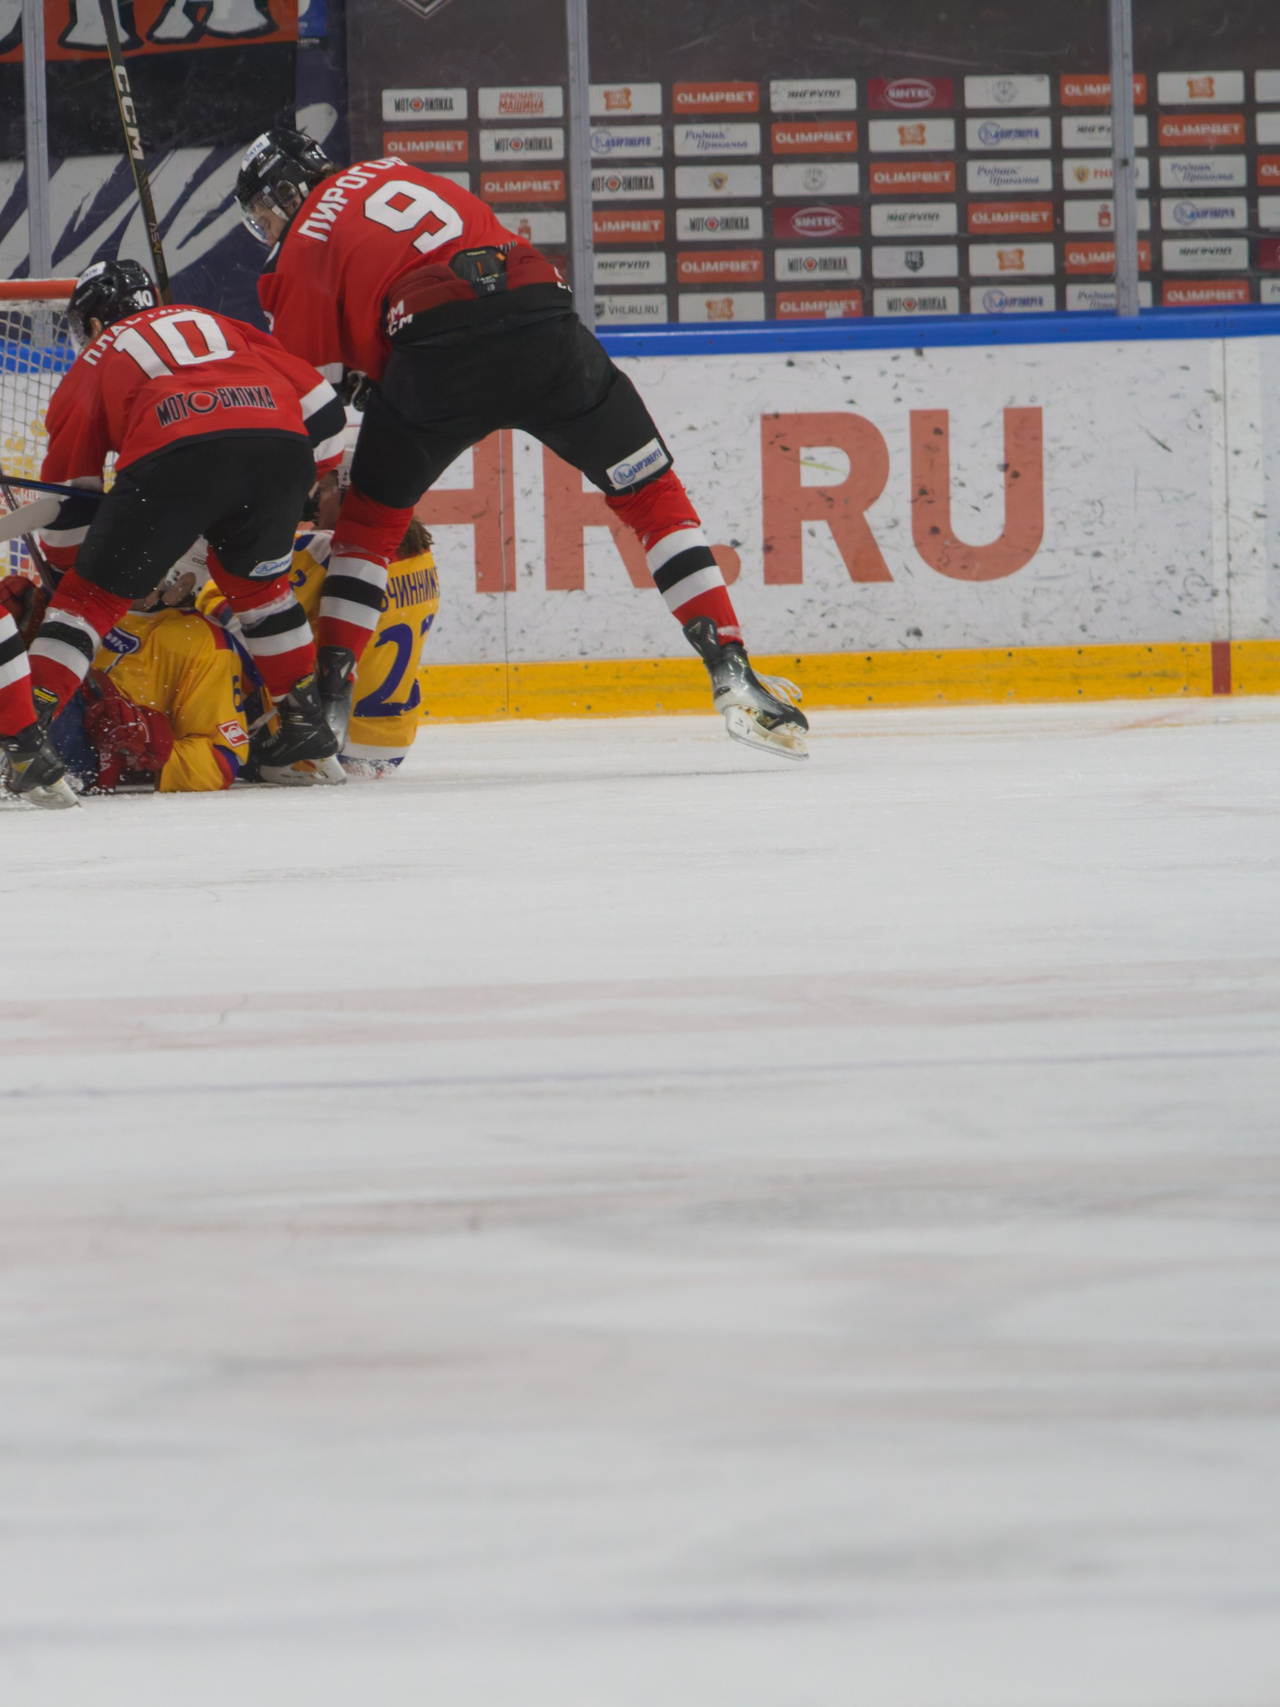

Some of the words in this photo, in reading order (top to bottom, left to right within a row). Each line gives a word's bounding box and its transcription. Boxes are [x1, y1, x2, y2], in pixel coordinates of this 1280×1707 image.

[1065, 83, 1143, 96] OLIMPT
[677, 91, 755, 104] OLIMPBET
[115, 65, 144, 160] CCM
[499, 99, 544, 113] МАШИНА
[1162, 124, 1241, 136] OLIMPBET
[776, 131, 853, 143] OLIMPBET
[387, 140, 465, 153] OLIMPBET
[874, 171, 951, 183] OLIMPBET
[484, 180, 561, 193] OLIMPBET
[364, 180, 464, 254] 9
[794, 216, 838, 228] SINTEC
[972, 211, 1049, 224] OLIMPBET
[593, 220, 661, 232] LIMPBET
[1069, 251, 1147, 264] OLIMPT
[681, 260, 759, 273] OLIMPBET
[133, 290, 154, 307] 10
[1167, 289, 1245, 302] OLIMPBET
[780, 300, 858, 312] OLIMPBET
[386, 313, 414, 336] CM
[112, 310, 235, 380] 10
[156, 386, 277, 428] МОТОВИЛИХА
